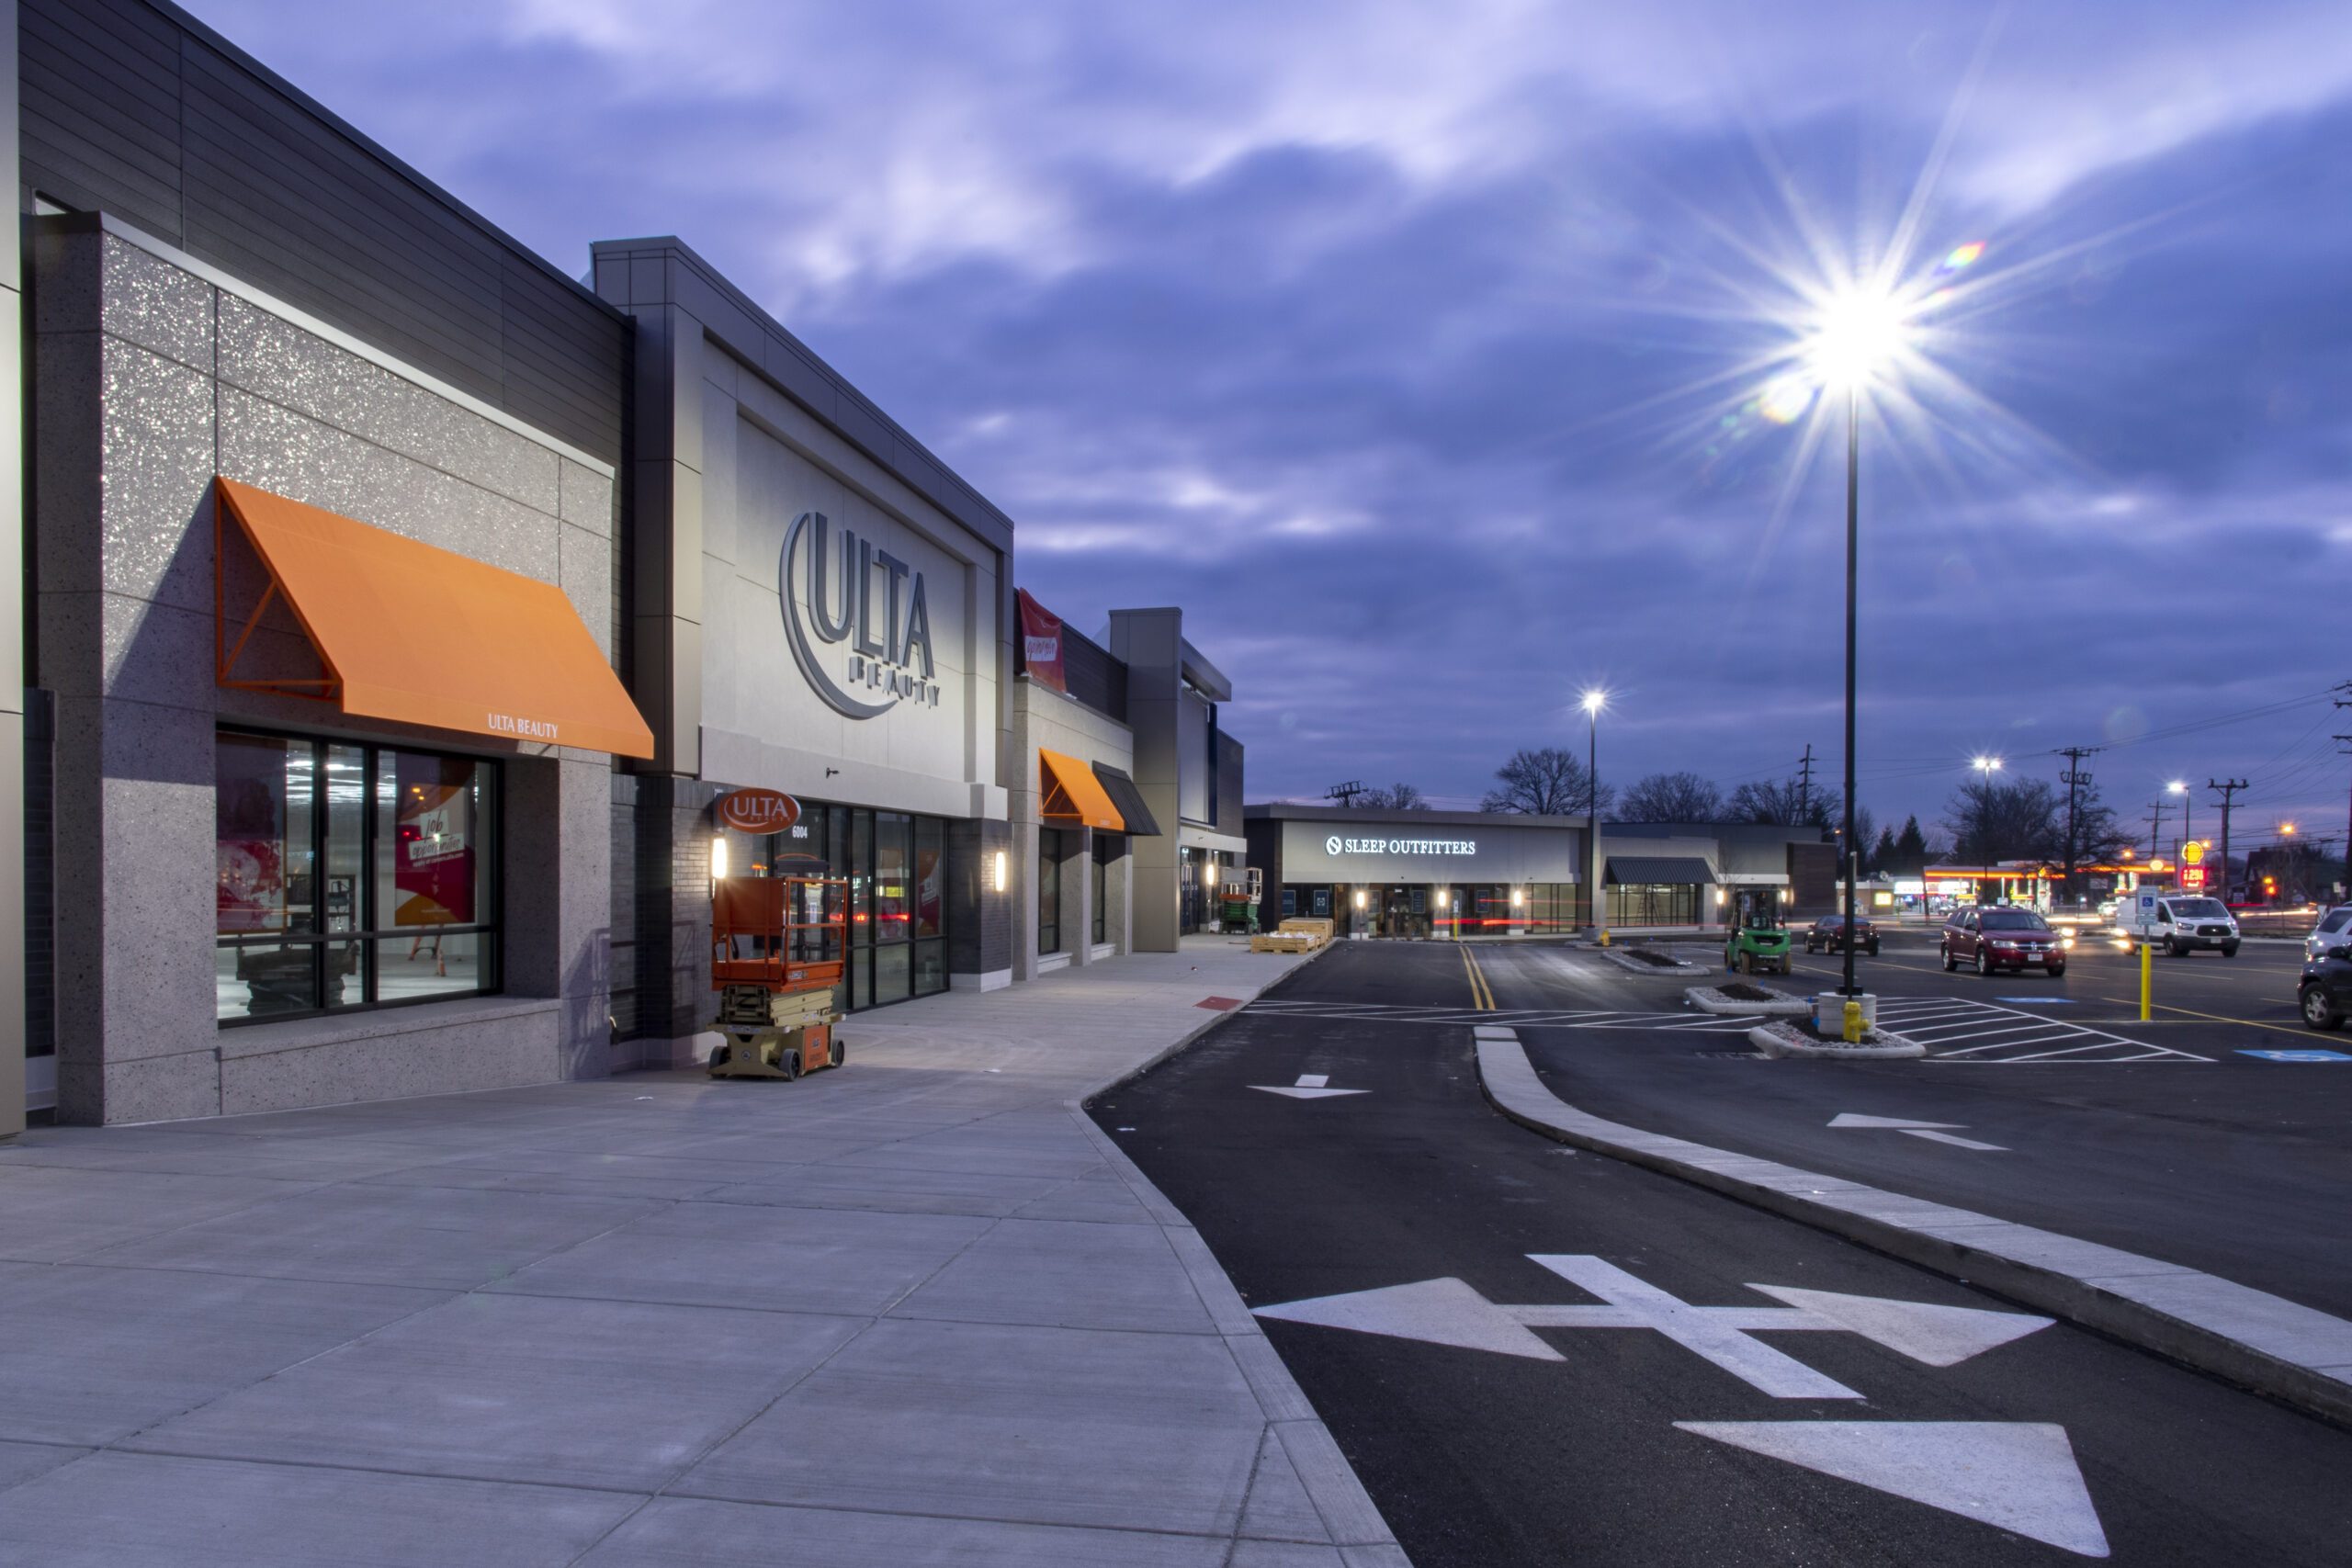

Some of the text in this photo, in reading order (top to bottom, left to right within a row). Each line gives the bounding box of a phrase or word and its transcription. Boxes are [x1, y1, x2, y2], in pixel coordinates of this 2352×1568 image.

[808, 512, 935, 681] ULTA
[849, 656, 941, 706] BEAUTY
[488, 713, 558, 739] ULTA BEAUTY
[733, 796, 788, 817] ULTA
[424, 809, 443, 843] job
[792, 825, 808, 839] 6004
[1344, 839, 1476, 855] SLEEP OUTFITTERS
